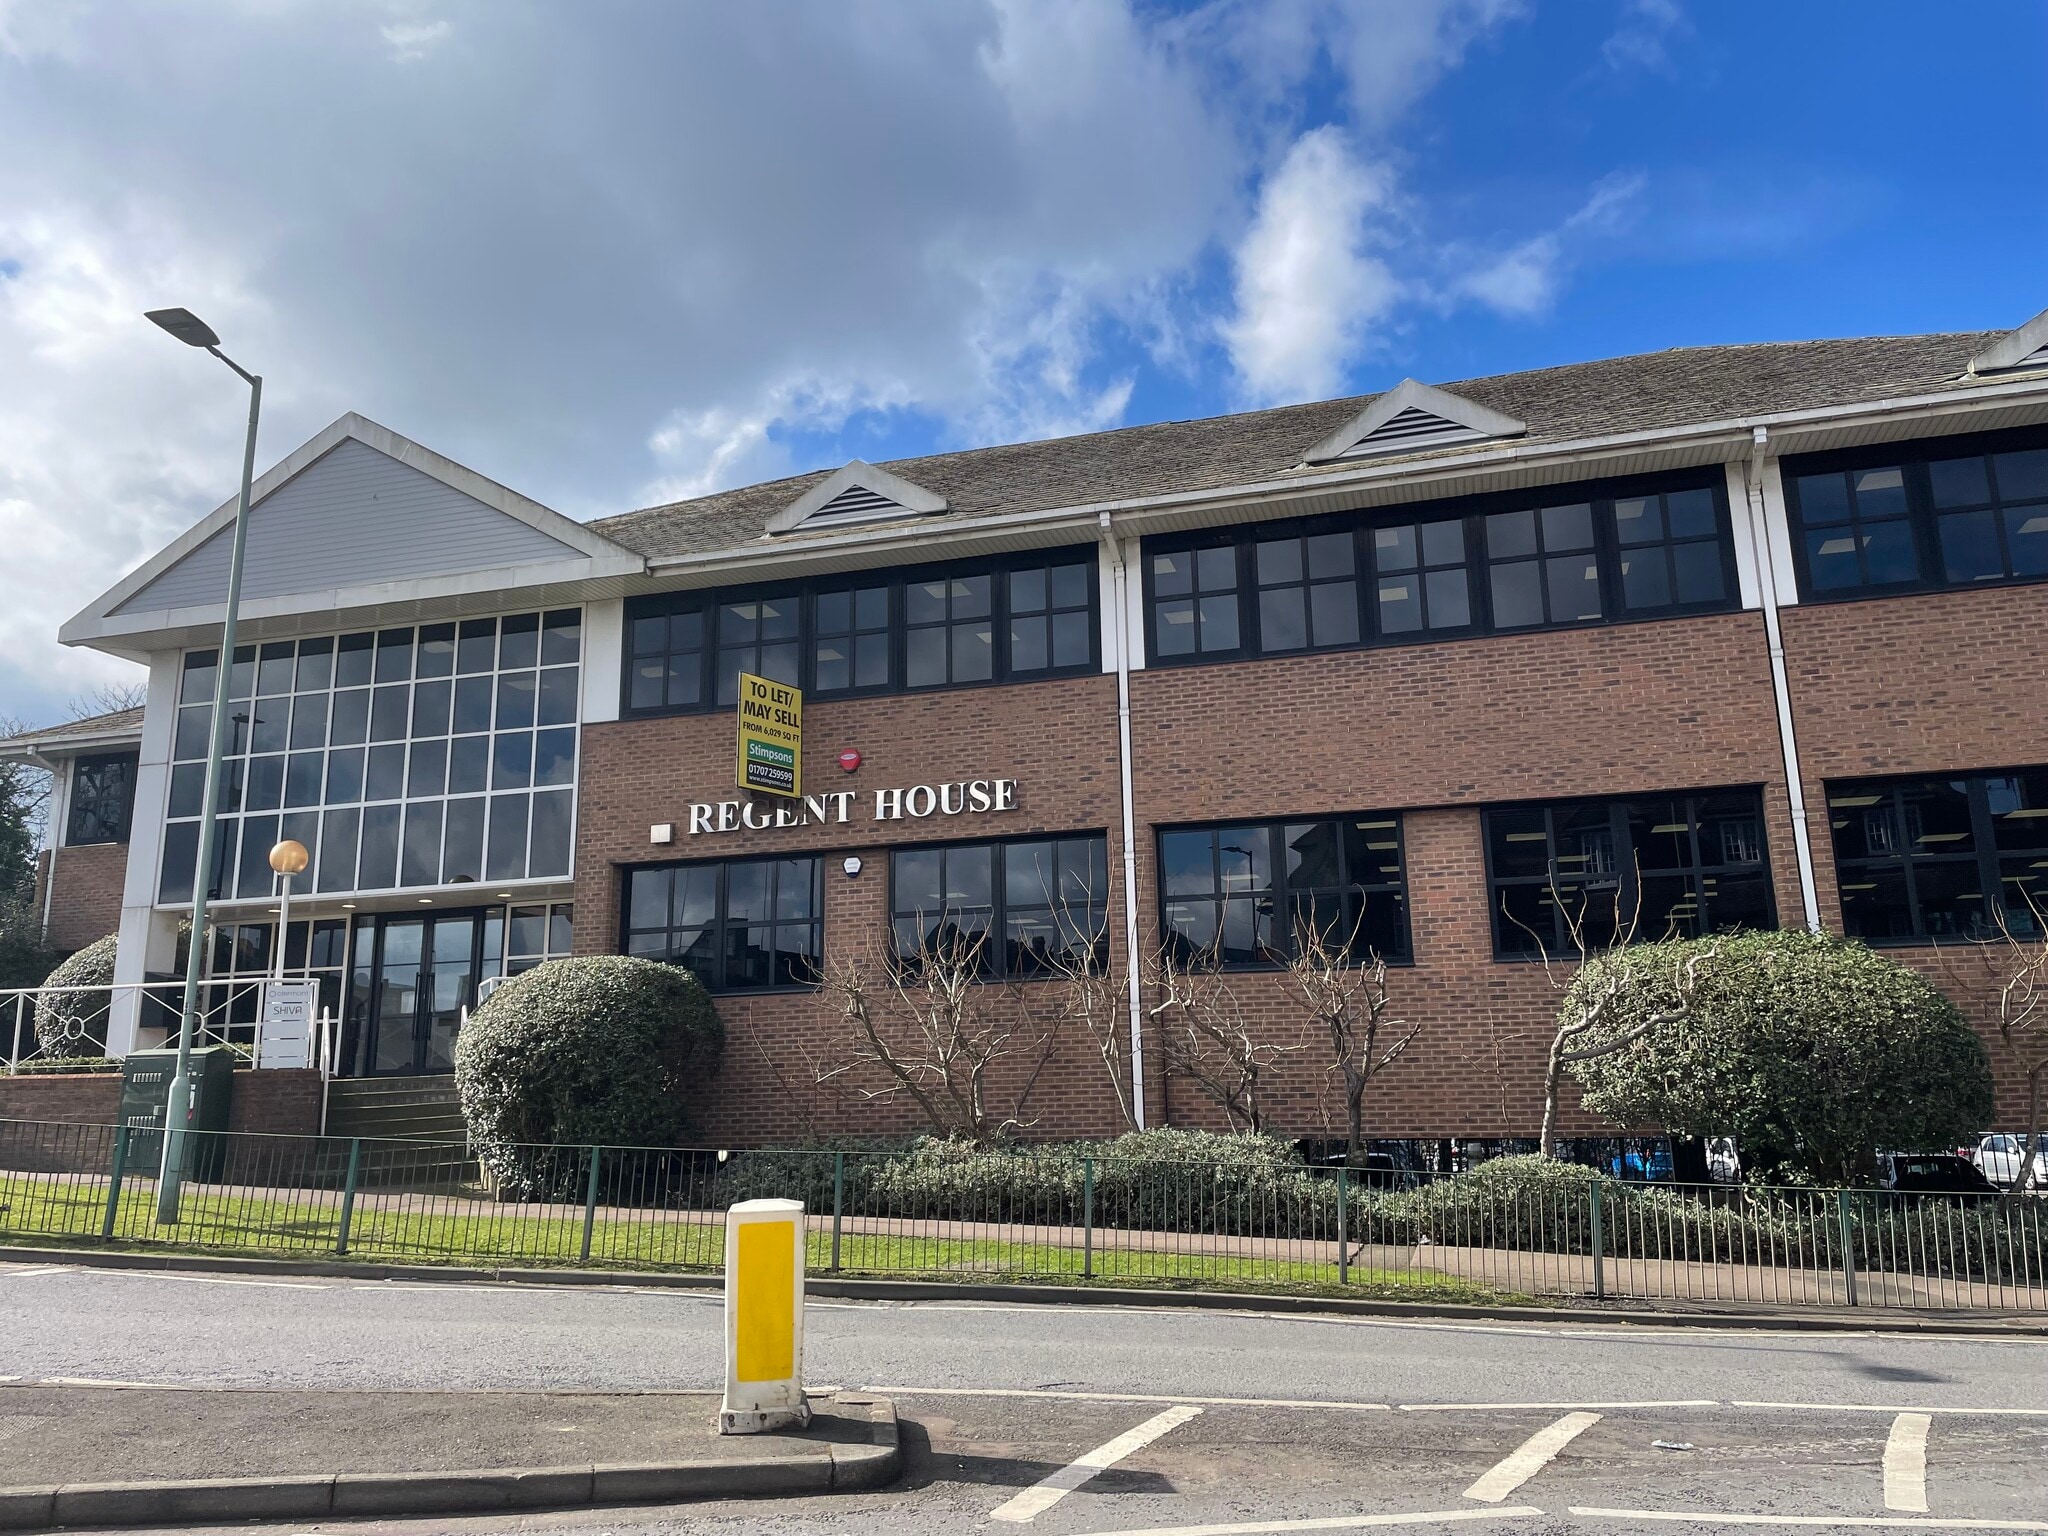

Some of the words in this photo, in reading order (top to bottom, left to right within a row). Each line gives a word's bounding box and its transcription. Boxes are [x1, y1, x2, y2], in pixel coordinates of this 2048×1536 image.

[750, 681, 767, 699] TO
[771, 687, 794, 708] LET/
[743, 700, 772, 720] MAY
[774, 708, 799, 728] SELL
[743, 721, 762, 733] FROM
[763, 726, 781, 738] 6,029
[783, 731, 791, 741] SQ
[792, 734, 800, 743] FT
[749, 743, 793, 763] Stimpsons
[687, 790, 856, 835] REGENT
[872, 778, 1018, 820] HOUSE
[273, 1006, 302, 1015] SHIVA
